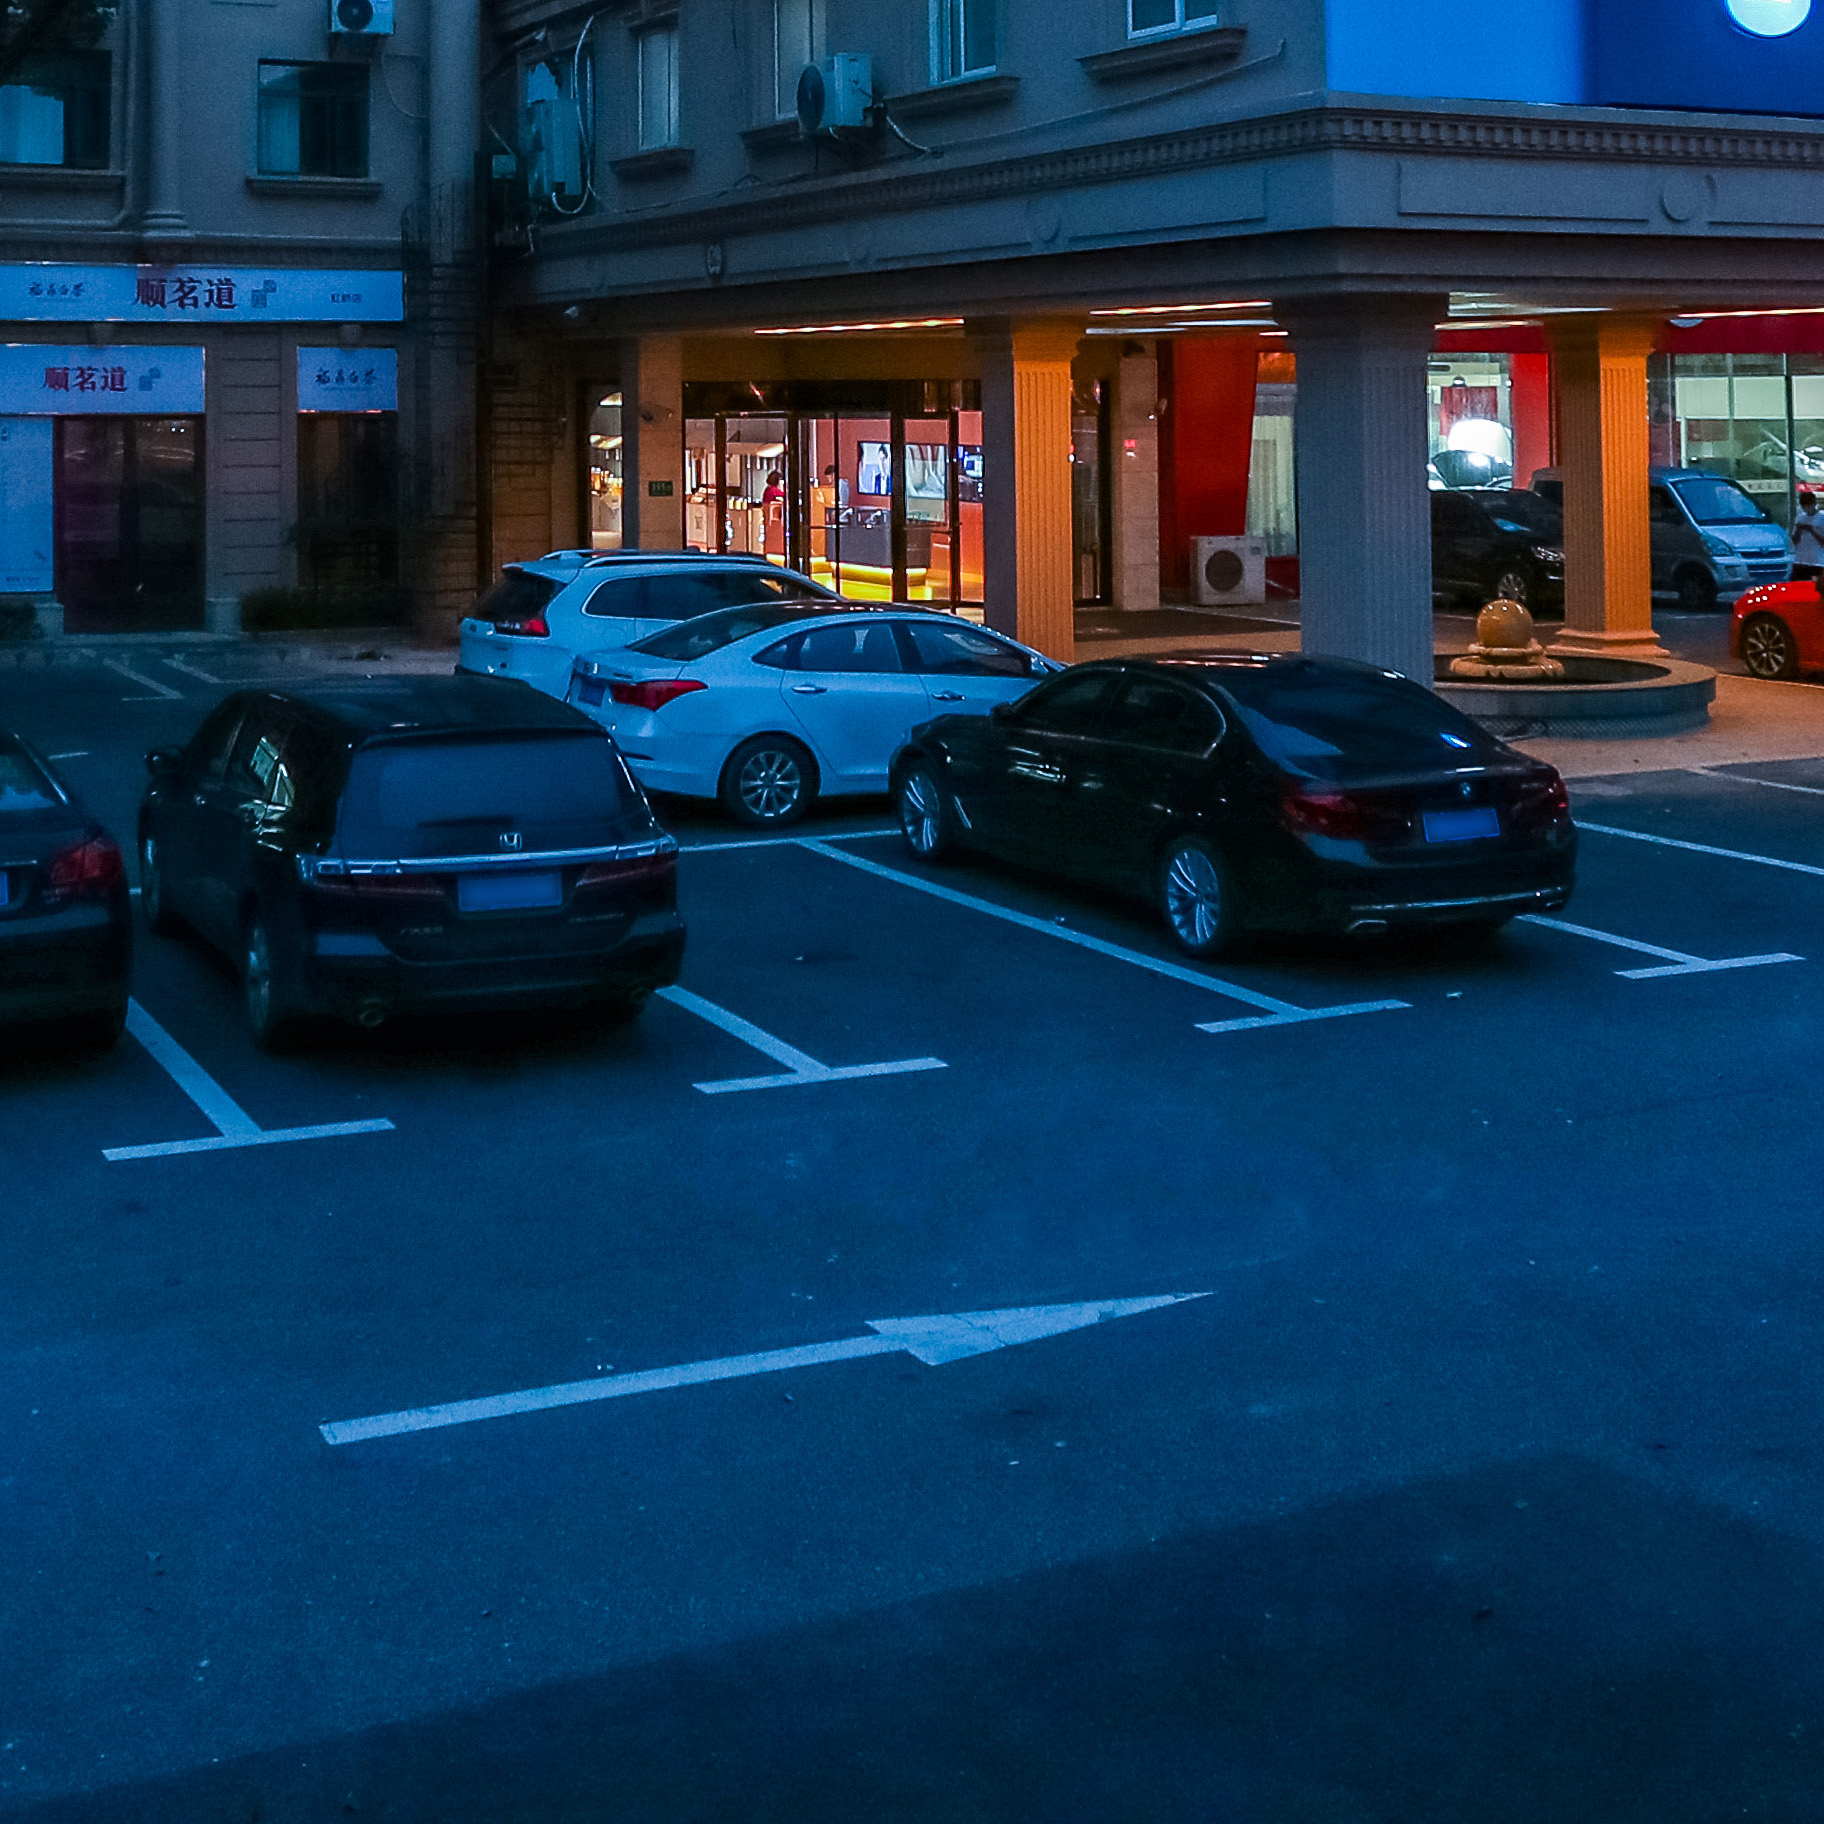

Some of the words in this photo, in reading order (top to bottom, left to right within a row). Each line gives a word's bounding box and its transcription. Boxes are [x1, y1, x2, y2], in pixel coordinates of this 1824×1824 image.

[133, 278, 237, 309] 顺茗道
[43, 366, 127, 392] 顺茗道
